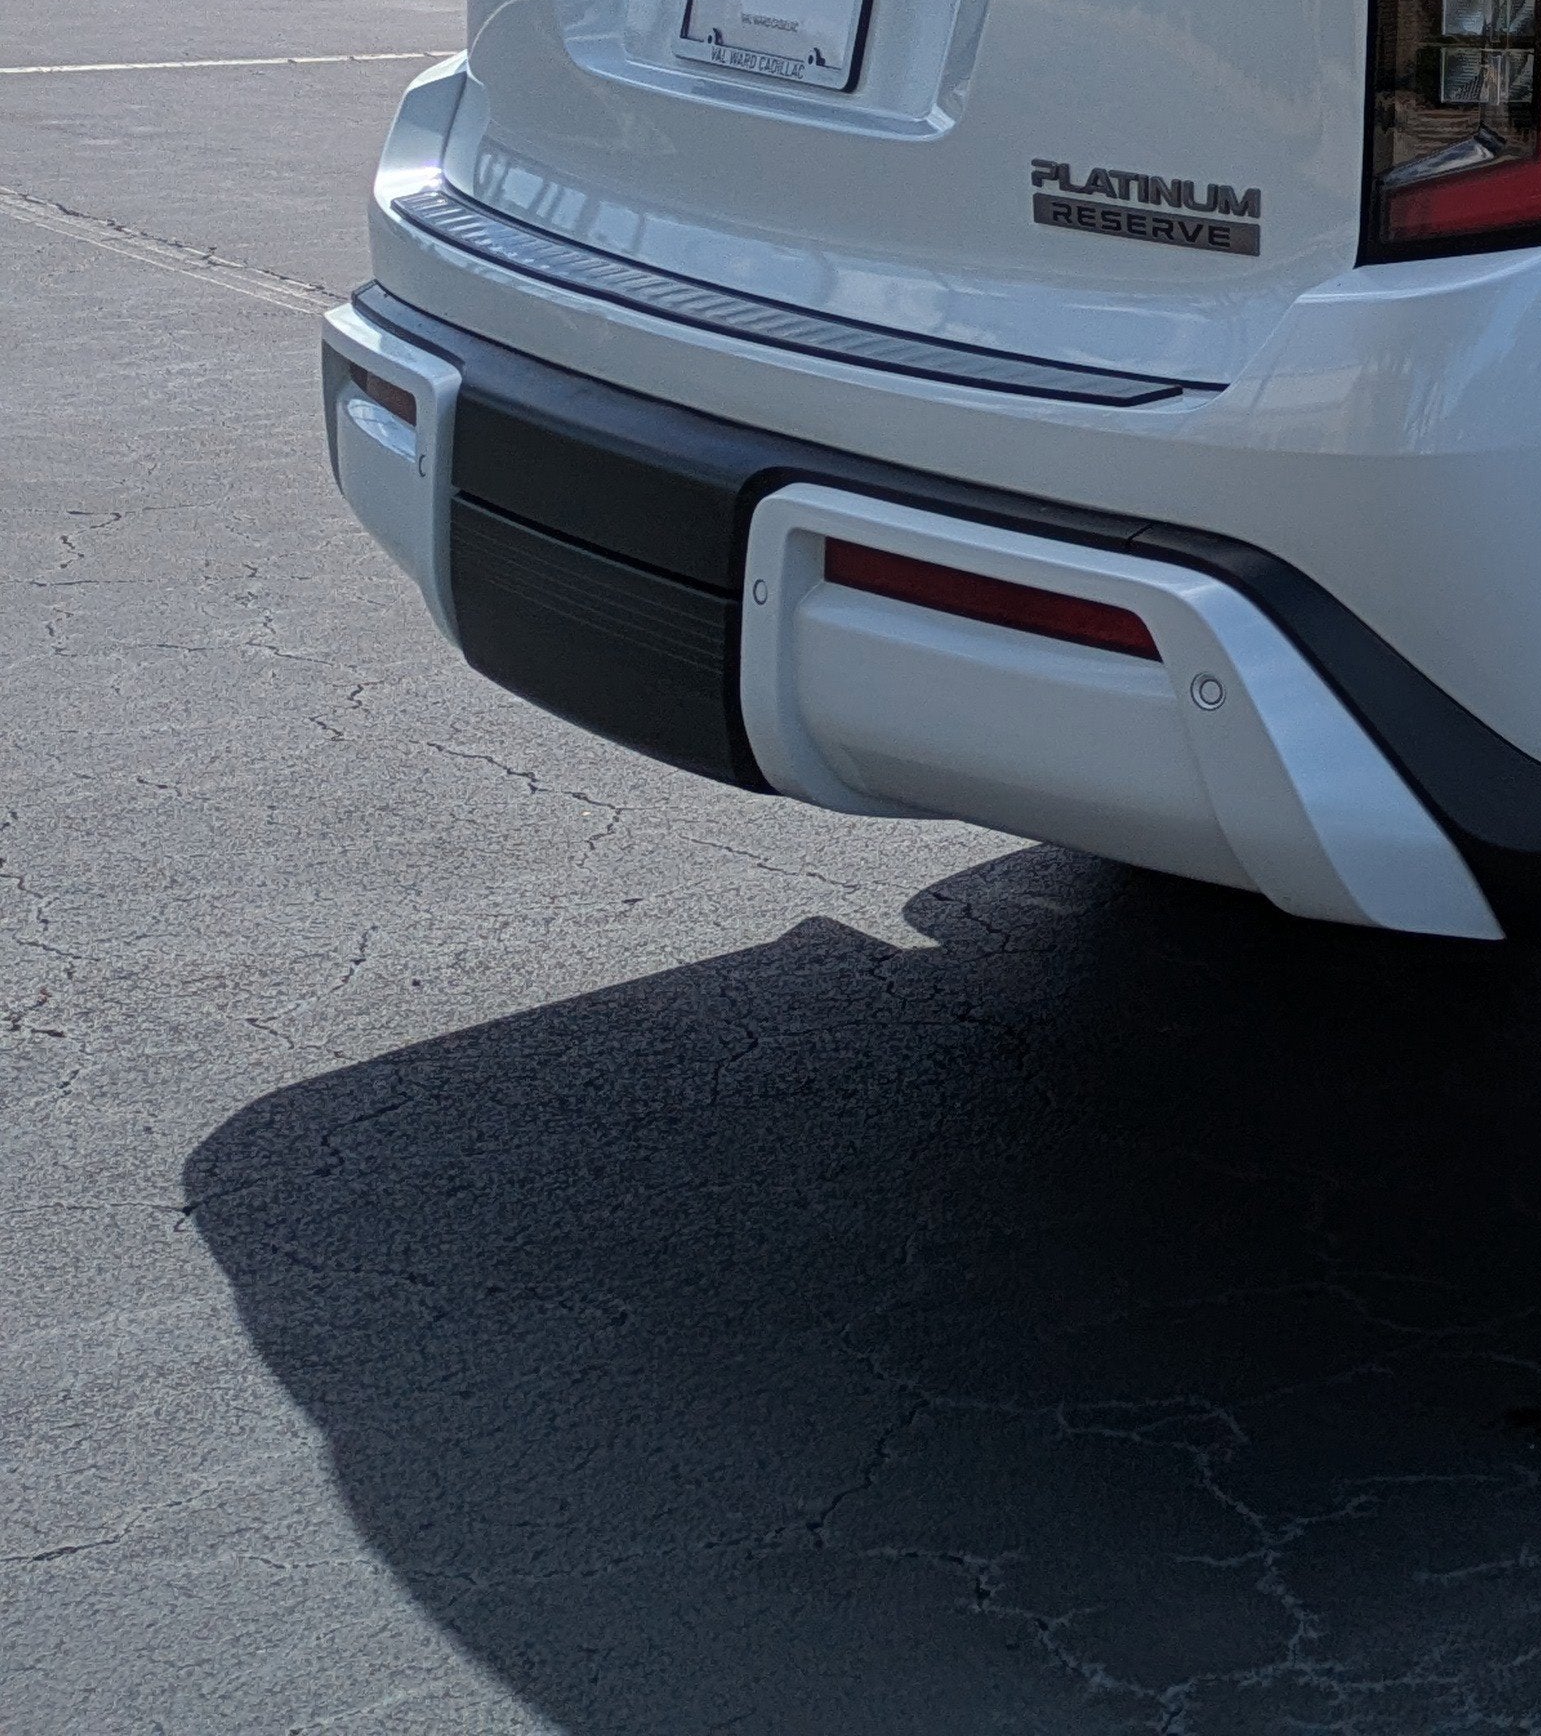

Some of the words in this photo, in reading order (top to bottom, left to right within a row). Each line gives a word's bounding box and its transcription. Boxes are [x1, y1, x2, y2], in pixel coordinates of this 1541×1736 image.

[711, 45, 726, 64] VAL
[730, 49, 757, 70] WARD
[758, 55, 805, 80] CADILLAC
[1031, 158, 1262, 219] PLATINUM
[1050, 201, 1231, 248] RESERVE
